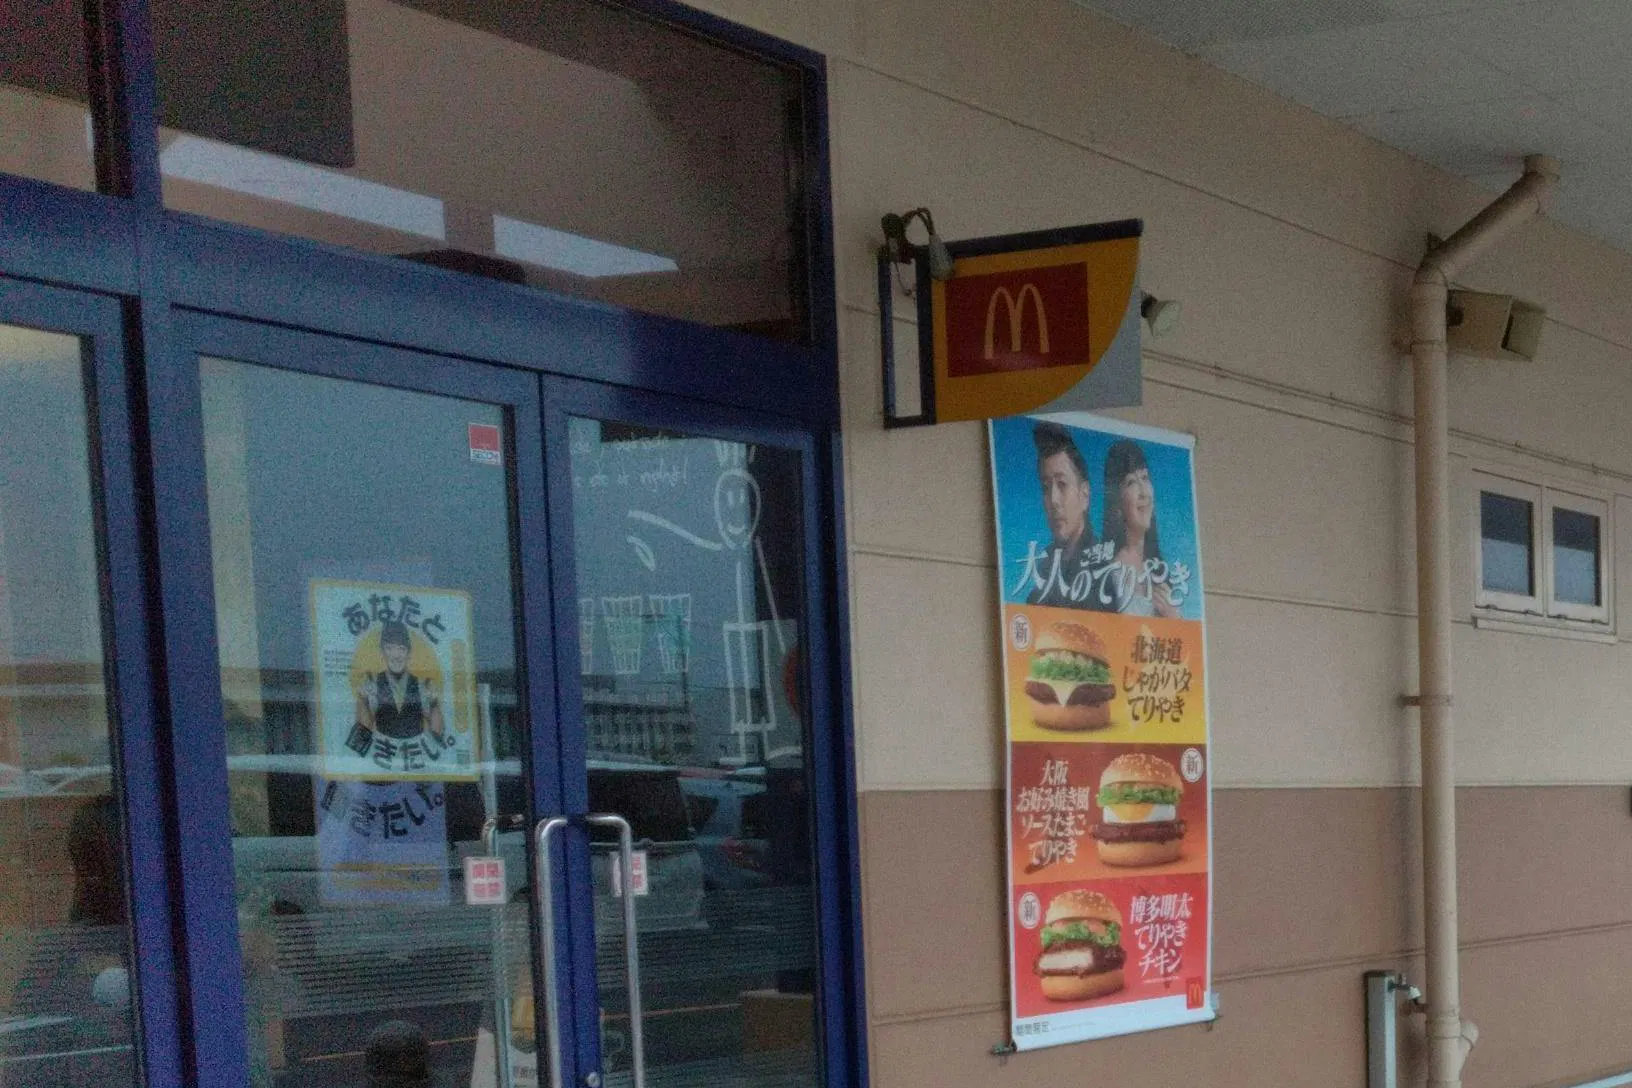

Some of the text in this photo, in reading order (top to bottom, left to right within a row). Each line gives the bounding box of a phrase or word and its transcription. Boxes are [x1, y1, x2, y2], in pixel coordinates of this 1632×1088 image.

[1011, 540, 1191, 613] 大人のてりやき
[342, 594, 446, 645] あなたと
[1131, 634, 1184, 665] 北海道
[1128, 696, 1185, 723] てりやき
[1039, 759, 1069, 785] 大阪
[1016, 786, 1090, 812] お好み焼き風
[1021, 812, 1087, 839] ソースたまご
[1028, 838, 1078, 865] てりやき
[1130, 892, 1193, 924] 博多明太
[1135, 921, 1187, 950] てりやき
[1138, 949, 1182, 977] チキン
